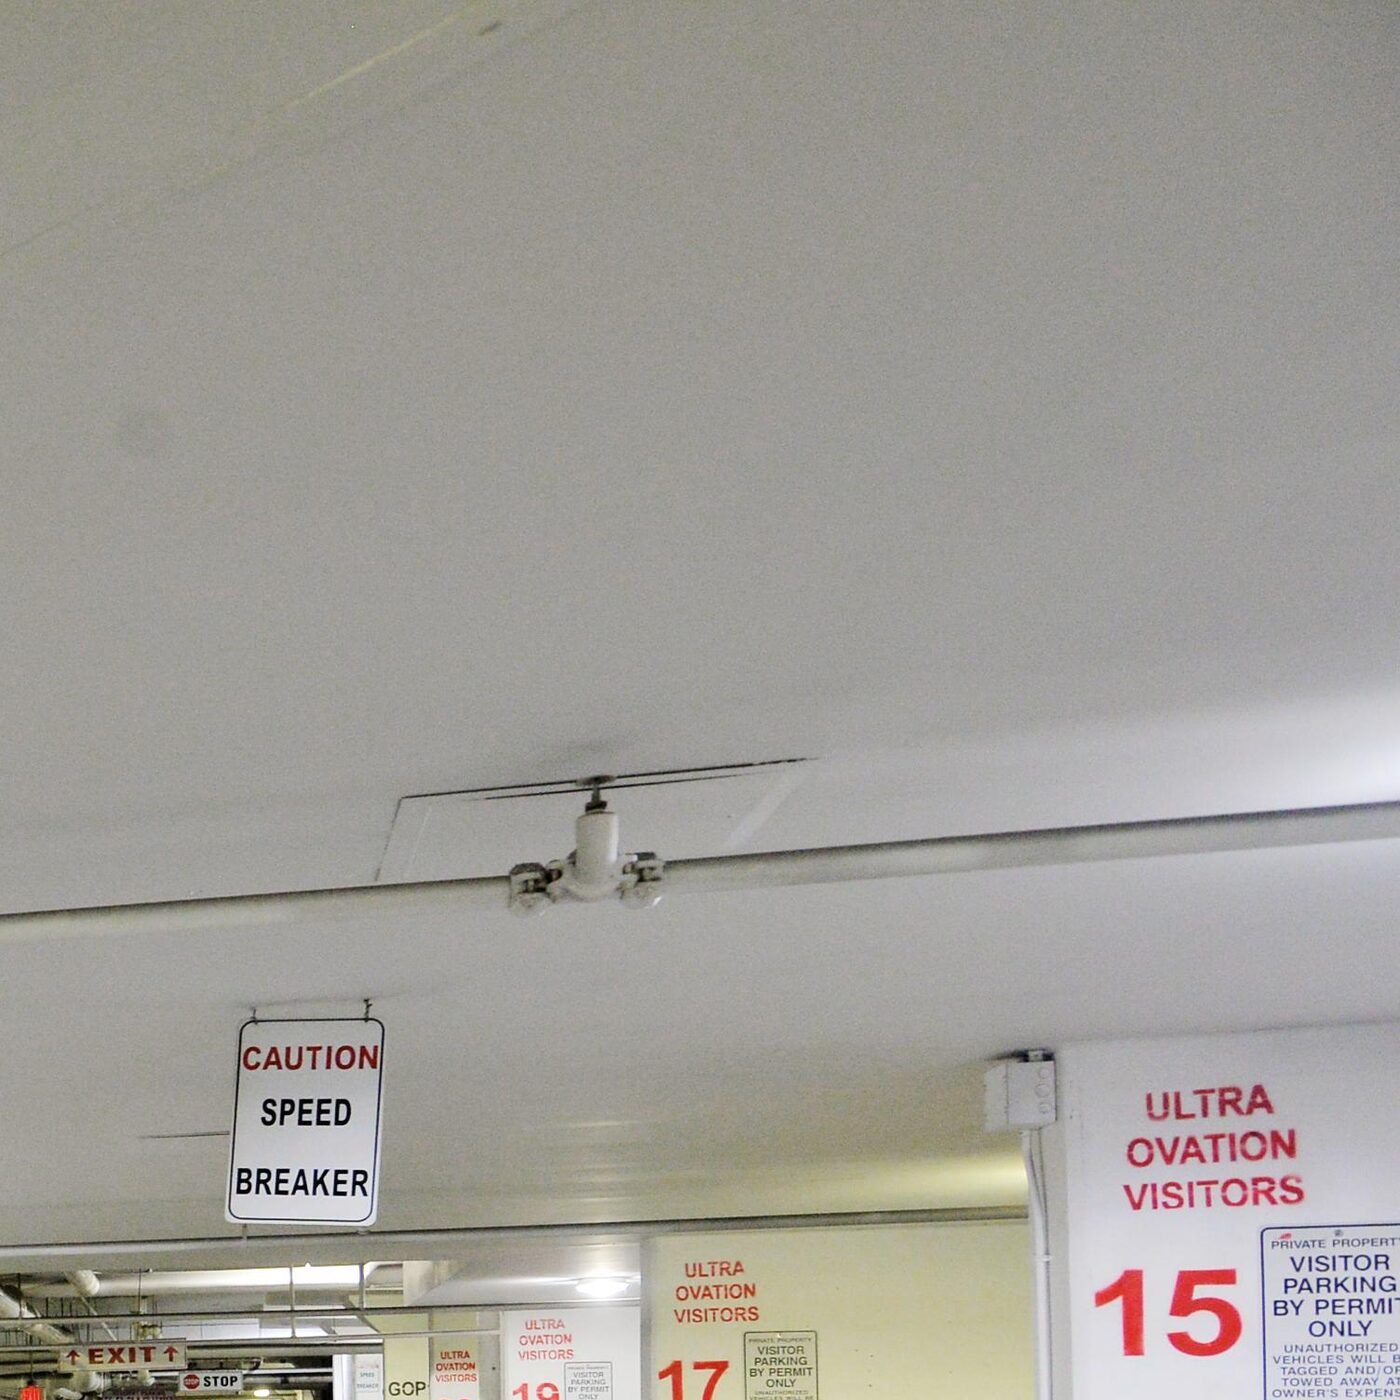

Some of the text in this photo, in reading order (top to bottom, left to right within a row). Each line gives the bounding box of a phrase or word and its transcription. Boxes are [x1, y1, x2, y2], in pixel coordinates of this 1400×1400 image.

[242, 1045, 379, 1071] CAUTION
[1145, 1084, 1275, 1122] ULTRA
[260, 1098, 352, 1126] SPEED
[1126, 1129, 1297, 1168] OVATION
[235, 1168, 368, 1198] BREAKER
[1123, 1174, 1305, 1211] VISITORS
[1271, 1239, 1326, 1249] PRIVATE
[685, 1260, 744, 1278] ULTRA
[1290, 1254, 1390, 1272] VISITOR
[1284, 1276, 1397, 1294] PARKING
[675, 1283, 756, 1301] OVATION
[1094, 1269, 1243, 1357] 15
[1273, 1300, 1304, 1316] BY
[674, 1306, 759, 1323] VISITORS
[525, 1319, 565, 1330] ULTRA
[1308, 1320, 1372, 1337] ONLY
[519, 1334, 572, 1346] OVATION
[757, 1346, 804, 1355] VISITOR
[1284, 1343, 1398, 1353] UNAUTHORIZED
[88, 1346, 156, 1364] EXIT
[440, 1350, 470, 1360] ULTRA
[518, 1349, 574, 1360] VISITORS
[1273, 1355, 1344, 1364] VEHICLES
[1351, 1355, 1385, 1364] WILL
[436, 1362, 476, 1371] OVATION
[754, 1356, 808, 1366] PARKING
[749, 1367, 813, 1377] BY PERMIT
[1281, 1366, 1338, 1376] TAGGED
[203, 1376, 238, 1387] STOP
[436, 1373, 477, 1382] VISITORS
[766, 1379, 797, 1388] ONLY
[1282, 1378, 1333, 1387] TOWED
[1340, 1377, 1378, 1386] AWAY
[388, 1381, 429, 1396] GOP
[1272, 1389, 1338, 1398] OWNER'S
